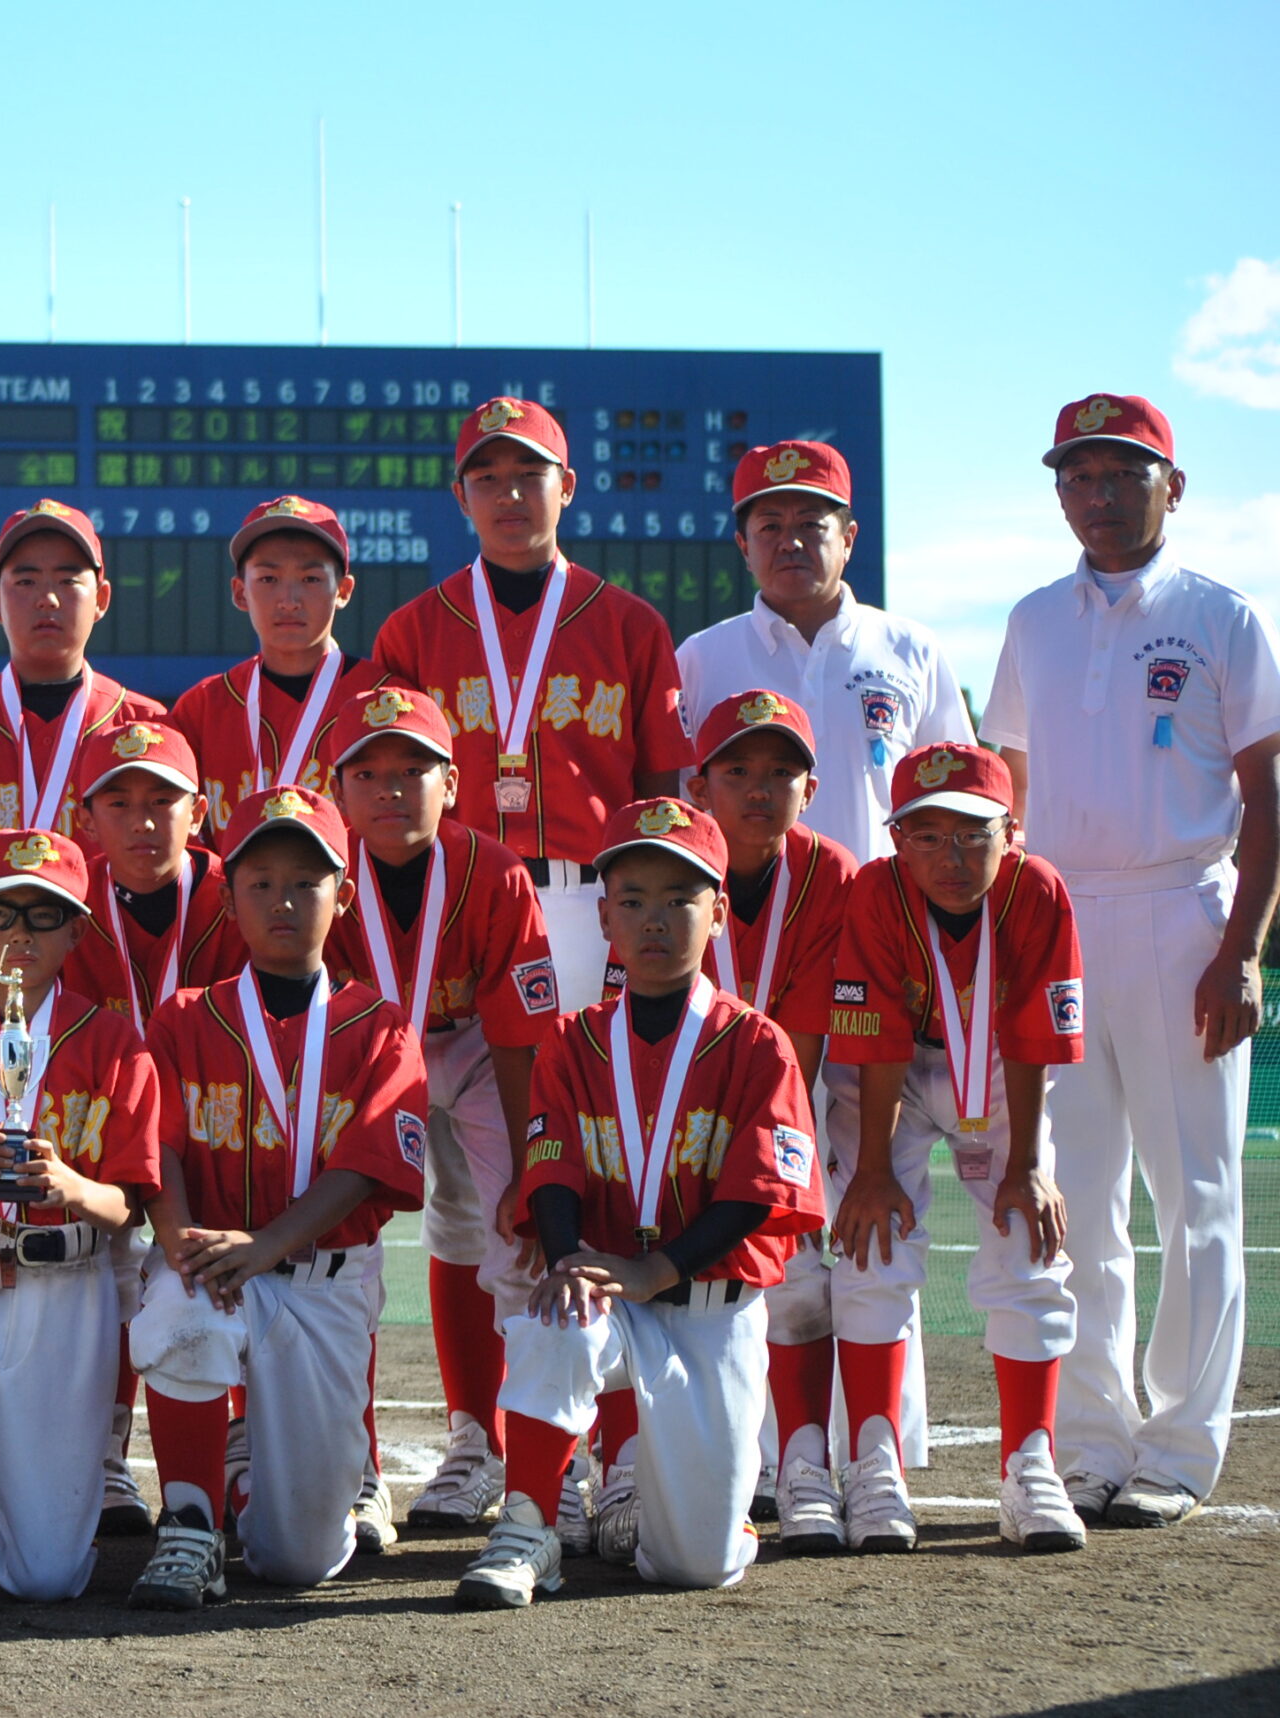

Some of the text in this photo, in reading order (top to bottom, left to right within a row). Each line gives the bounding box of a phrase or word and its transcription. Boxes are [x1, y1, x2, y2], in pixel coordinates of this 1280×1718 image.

[105, 378, 117, 402] 1
[139, 378, 156, 402] 2
[175, 378, 191, 403] 3
[208, 380, 225, 402] 4
[245, 379, 261, 404] 5
[278, 380, 296, 404] 6
[314, 380, 331, 404] 7
[349, 380, 366, 405] 8
[384, 381, 401, 405] 9
[413, 382, 440, 405] 10
[451, 382, 469, 405] R
[504, 383, 523, 401] H
[539, 383, 555, 406] E
[594, 410, 609, 431] S
[705, 411, 722, 431] H
[594, 440, 610, 461] B
[707, 442, 720, 462] E
[90, 509, 105, 532] 6
[122, 510, 139, 533] 7
[157, 509, 174, 533] 8
[193, 510, 210, 533] 9
[577, 512, 729, 537] 3 4 5 6 7
[829, 1009, 880, 1036] KKAIDO
